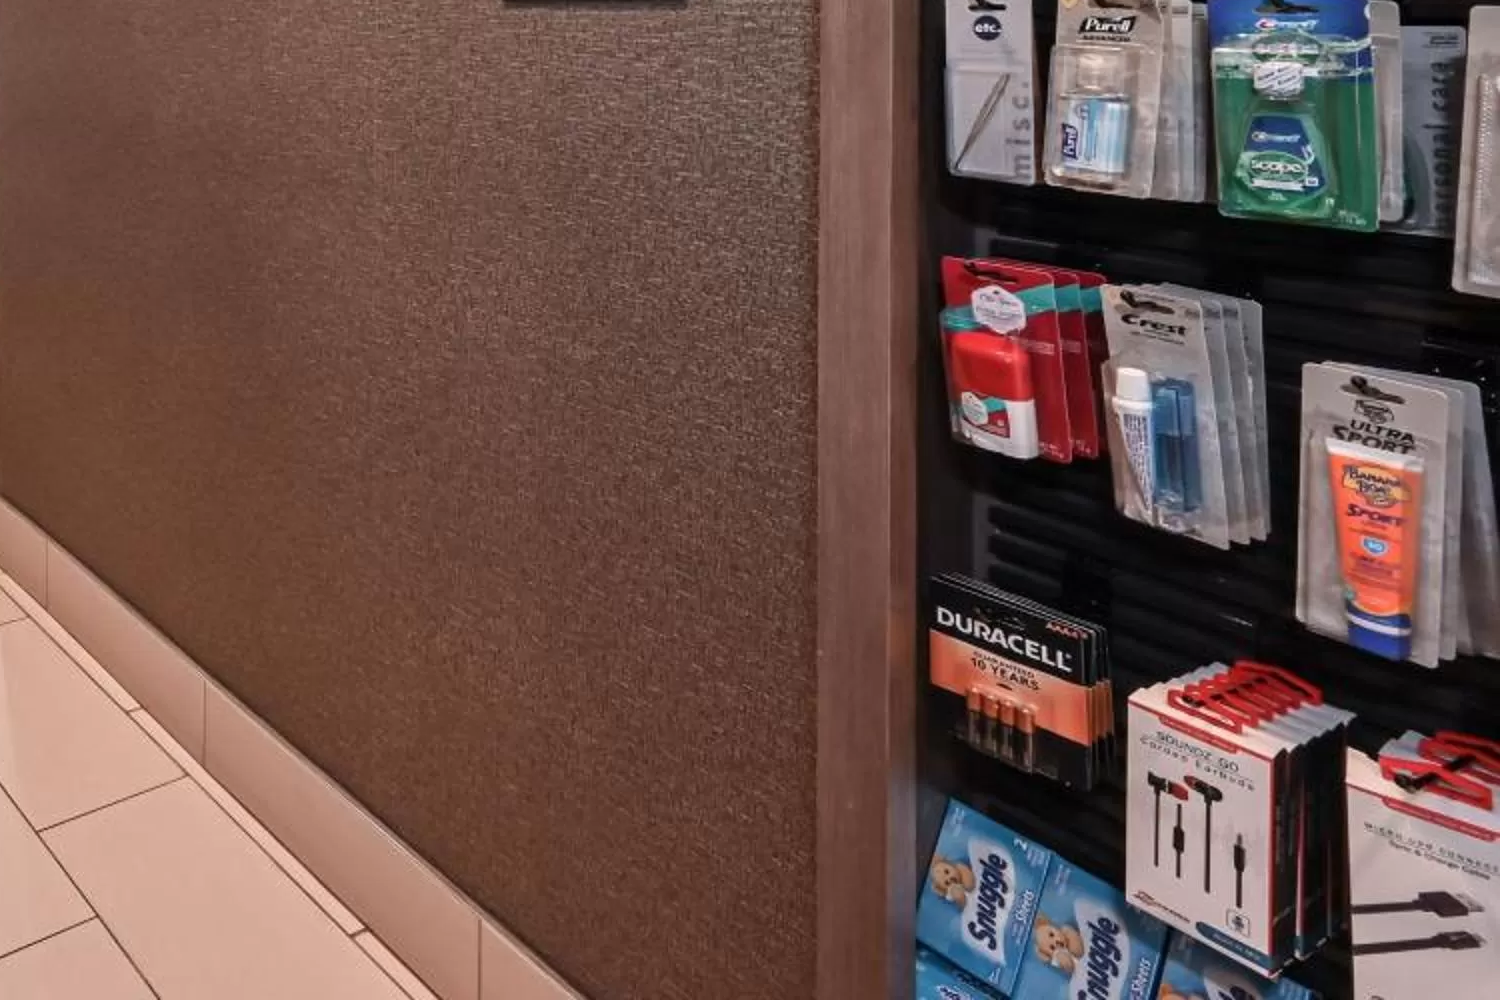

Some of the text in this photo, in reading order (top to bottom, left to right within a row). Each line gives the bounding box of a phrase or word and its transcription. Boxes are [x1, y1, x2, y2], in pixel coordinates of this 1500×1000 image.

[974, 22, 1002, 34] etc.
[1005, 81, 1031, 179] misc.
[1120, 313, 1187, 337] Crest
[1332, 424, 1416, 454] SPORT
[1350, 419, 1416, 444] ULTRA
[1347, 503, 1407, 527] SPORT
[936, 605, 1072, 673] DURACELL
[972, 657, 1040, 691] 10 YEARS
[967, 852, 1008, 951] Snuggle
